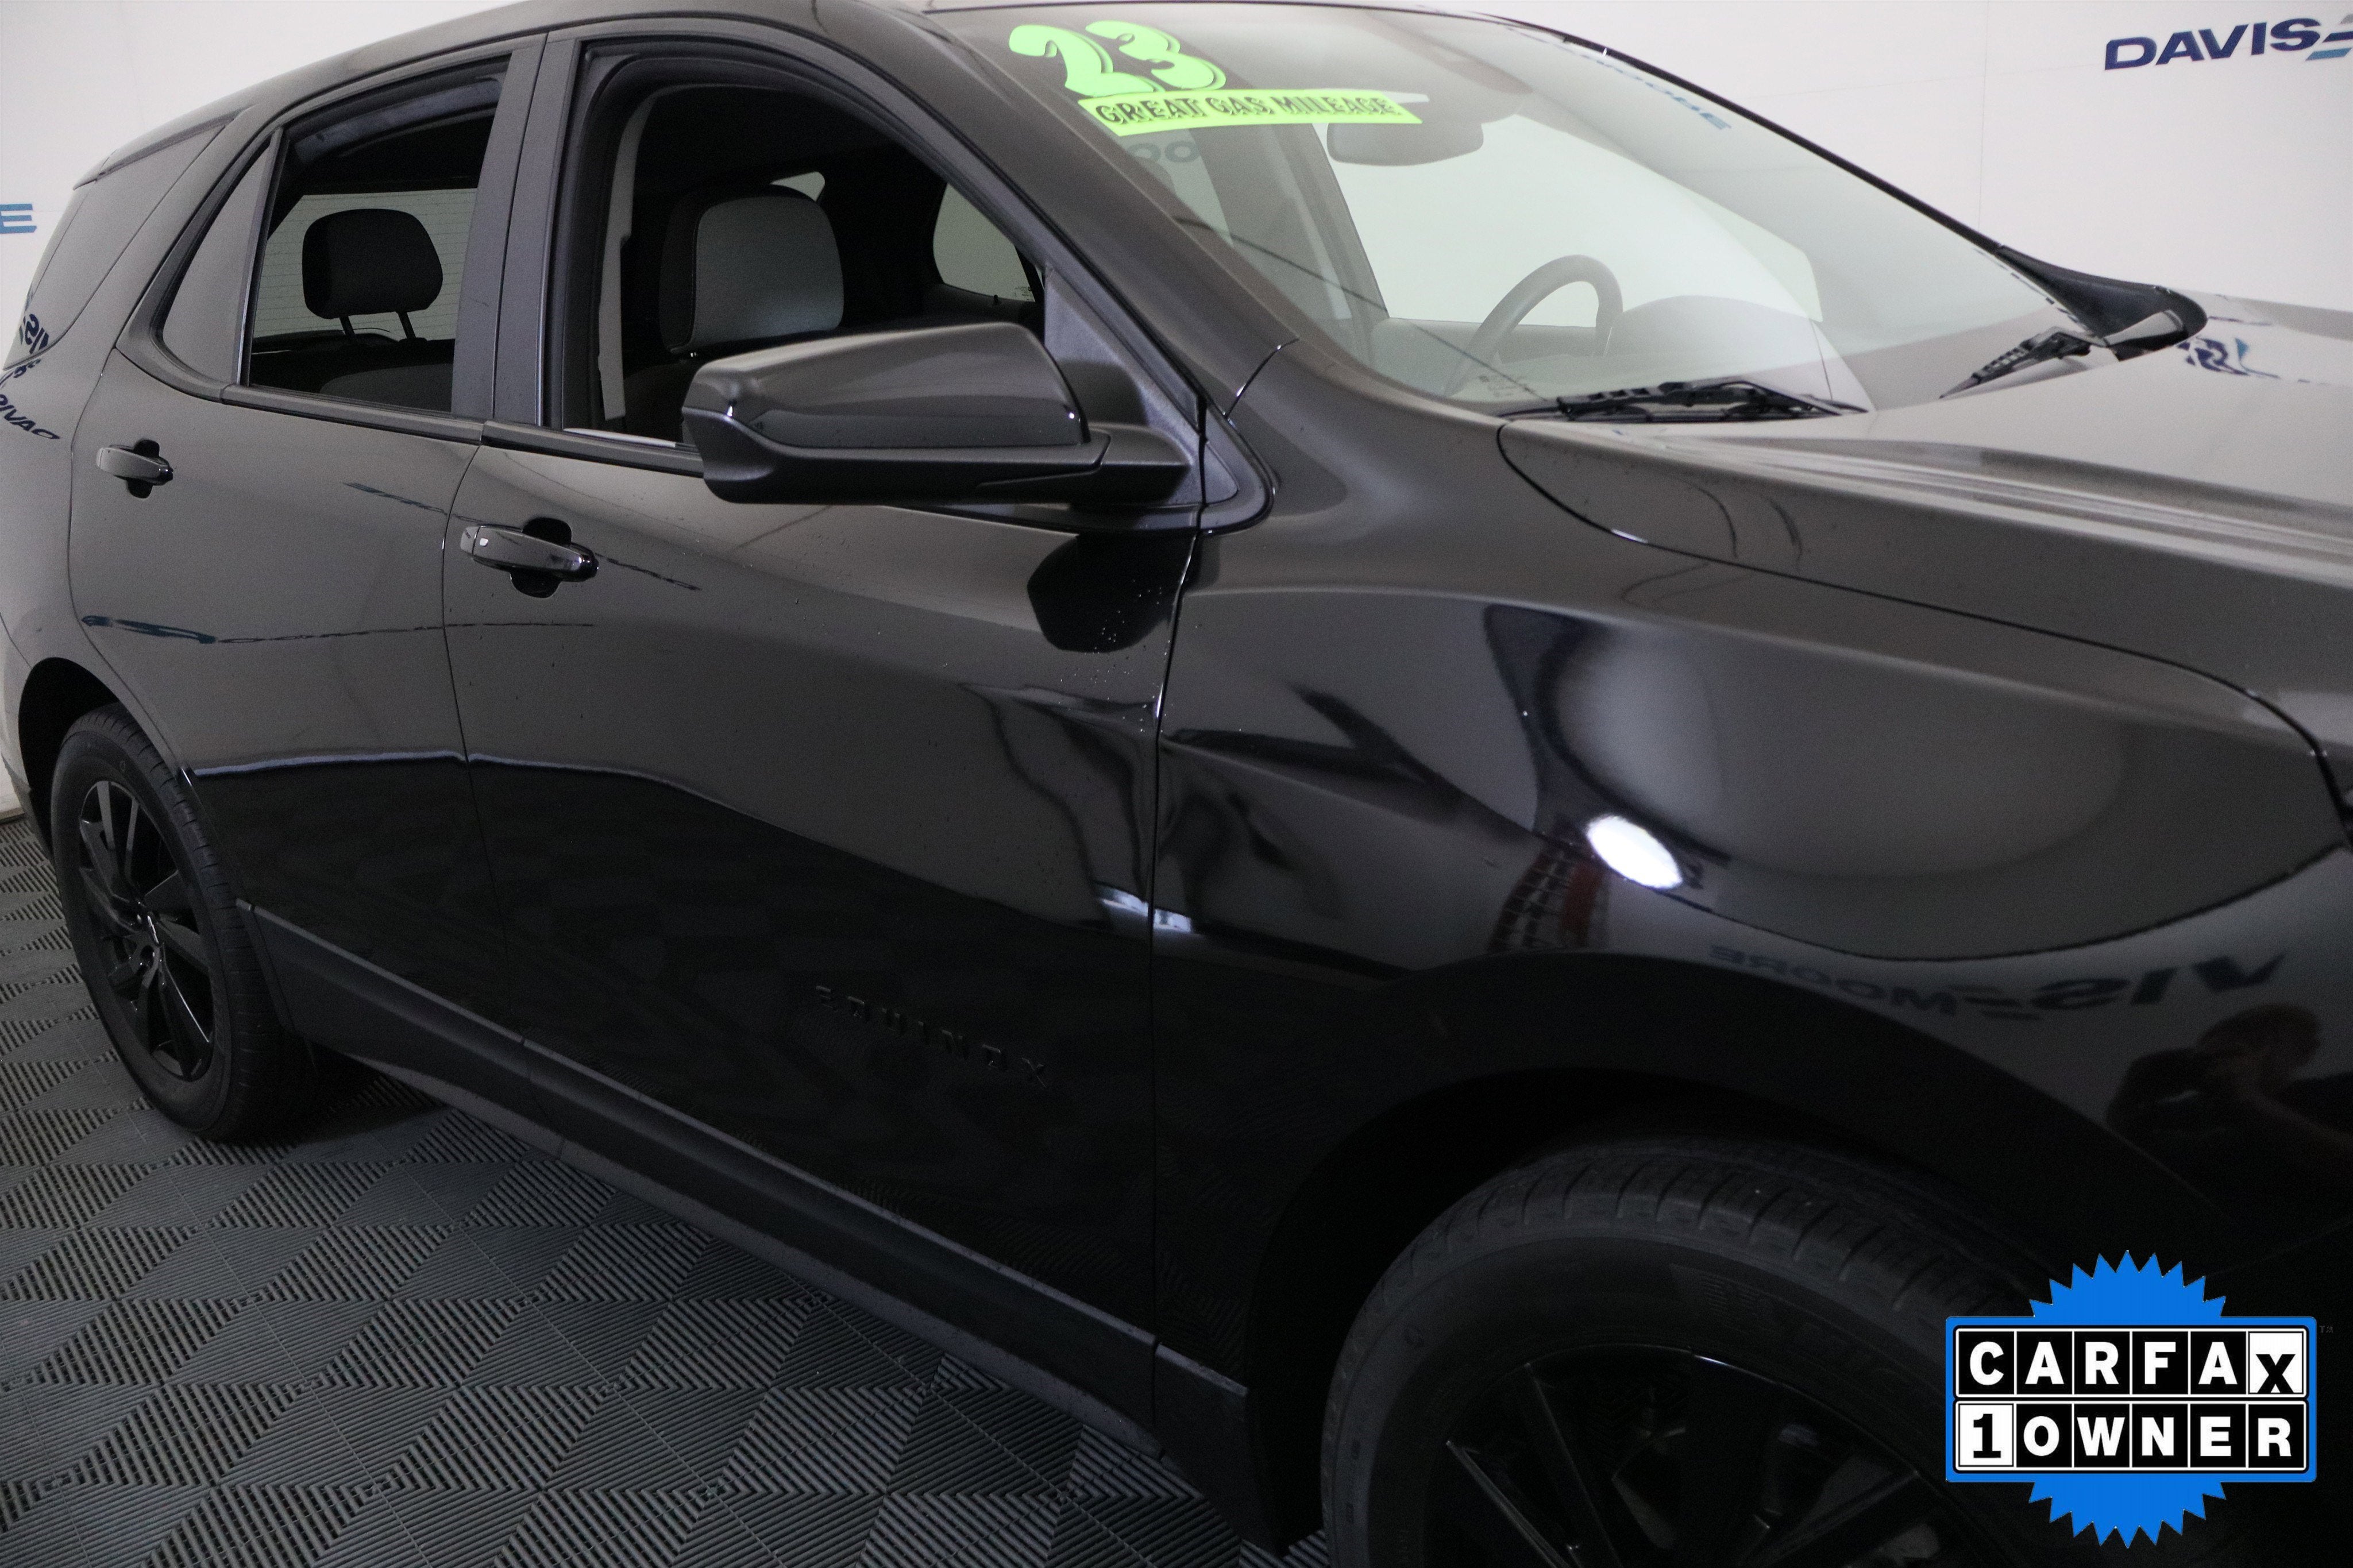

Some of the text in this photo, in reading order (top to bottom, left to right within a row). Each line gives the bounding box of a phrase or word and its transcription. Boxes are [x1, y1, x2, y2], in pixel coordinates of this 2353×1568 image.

[1009, 20, 1226, 98] 23
[2104, 18, 2321, 71] DAVIS
[1095, 96, 1403, 124] GREAT GAS MILEAGE
